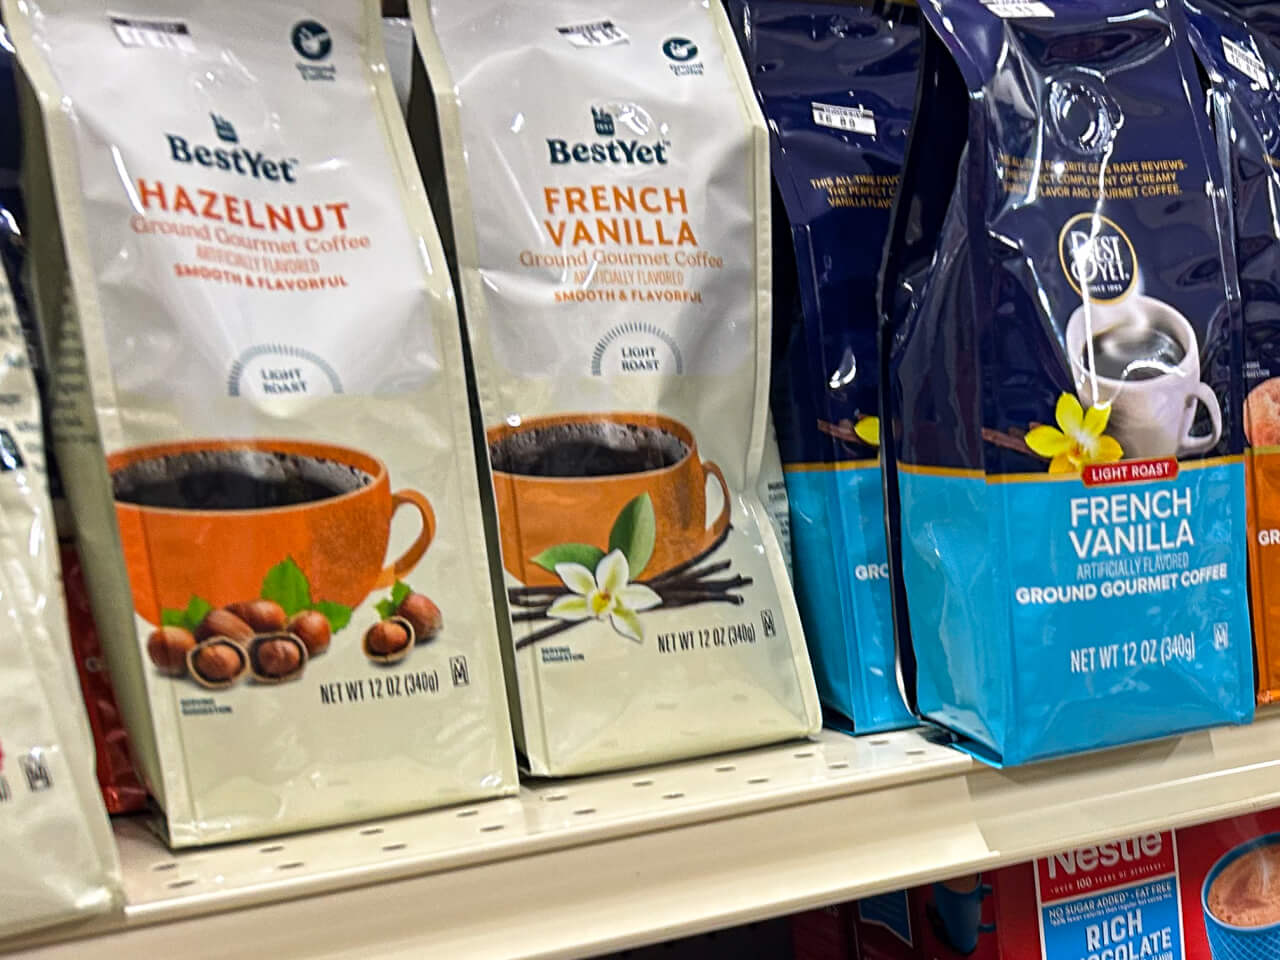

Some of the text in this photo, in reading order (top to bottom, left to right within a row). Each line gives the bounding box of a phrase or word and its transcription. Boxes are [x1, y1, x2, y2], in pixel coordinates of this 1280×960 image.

[165, 133, 298, 184] BestYet
[546, 137, 667, 165] BestYet
[135, 178, 351, 233] HAZELNUT
[542, 184, 689, 215] FRENCH
[130, 215, 371, 255] Ground Gourmet Coffee
[543, 218, 698, 247] VANILLA
[519, 249, 724, 268] Ground Gourmet Coffee
[174, 263, 348, 291] SMOOTH FLAVORFUL
[554, 290, 703, 305] SMOOTH FLAVORFUL
[621, 347, 655, 359] LIGHT
[621, 360, 660, 371] ROAST
[1091, 462, 1169, 483] LIGHT ROAST
[1069, 487, 1193, 527] FRENCH
[1068, 520, 1195, 559] VANILLA
[1076, 551, 1190, 581] ARTIFICIALLY FLAVORED
[1016, 562, 1229, 606] GROUND GOURMET COFFEE
[657, 628, 726, 654] NET WT 12 OZ
[1070, 631, 1195, 673] NET WT 12 OZ (340g)
[320, 669, 440, 704] NET WT 12 OZ (340g)
[1064, 899, 1095, 915] SUGAR
[1085, 908, 1144, 954] RICH
